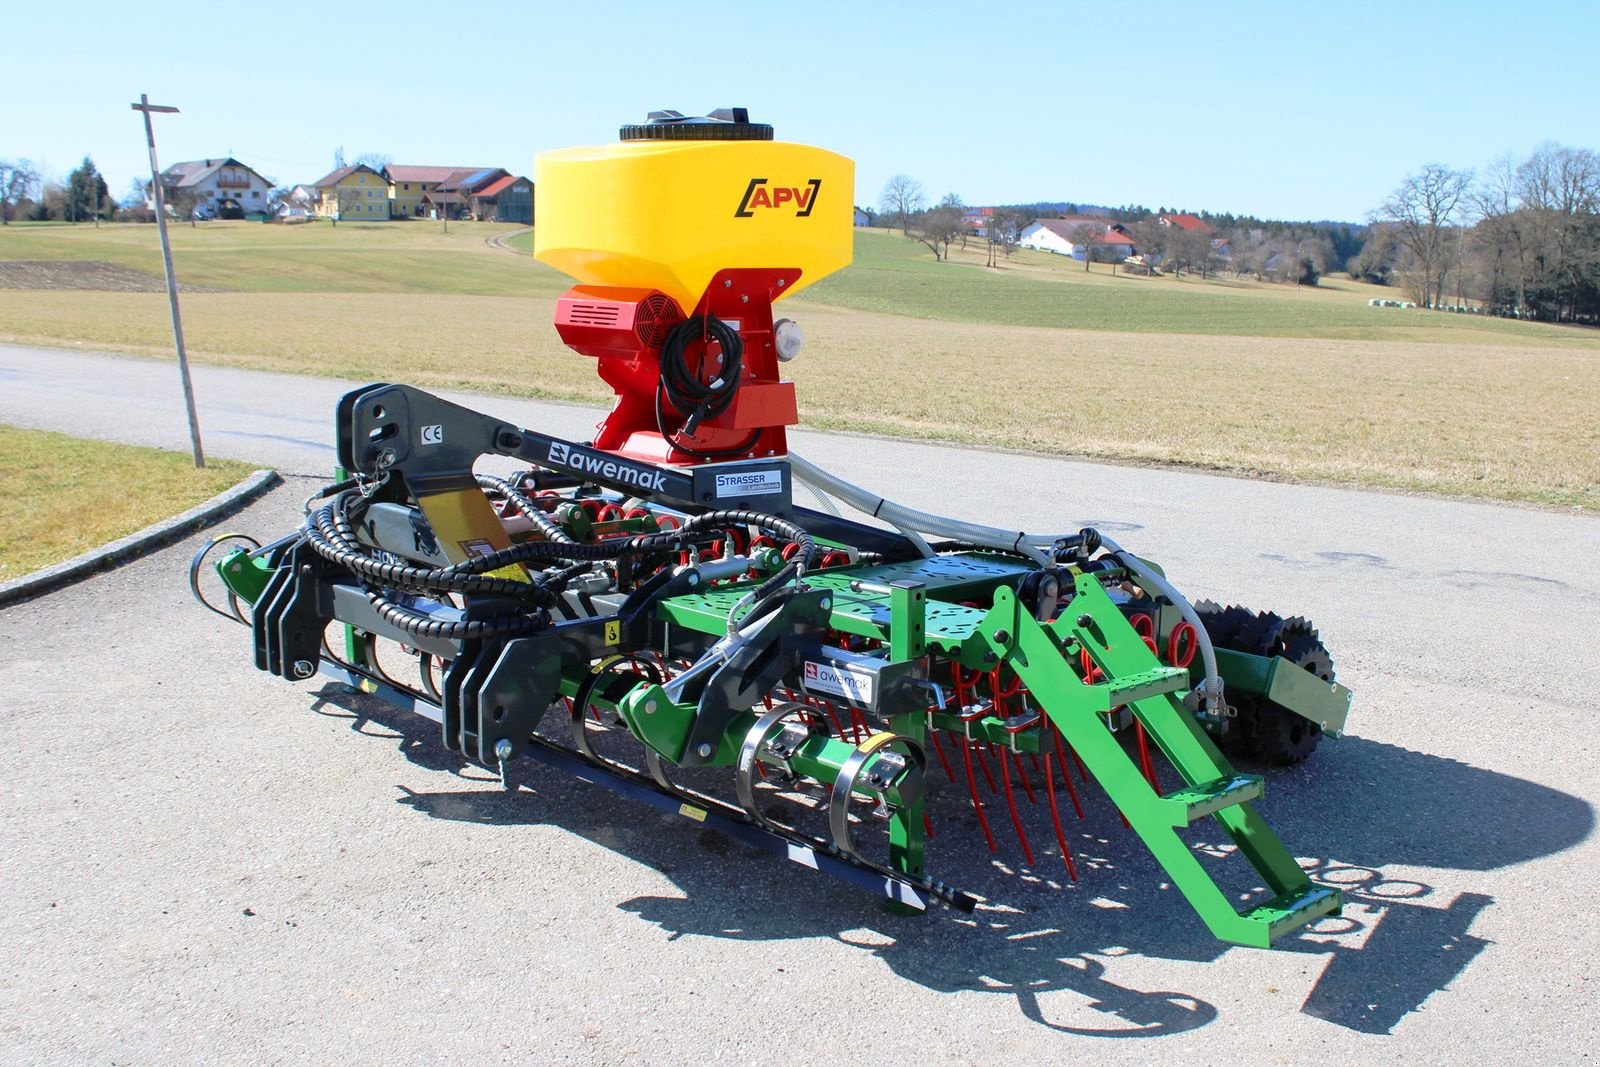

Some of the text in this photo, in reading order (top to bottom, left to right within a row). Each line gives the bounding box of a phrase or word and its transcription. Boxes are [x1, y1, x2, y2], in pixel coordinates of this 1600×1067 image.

[749, 187, 811, 208] APV
[423, 425, 441, 441] CE
[569, 452, 667, 492] awemak
[717, 474, 765, 486] STRASSER
[820, 670, 868, 690] awemak
